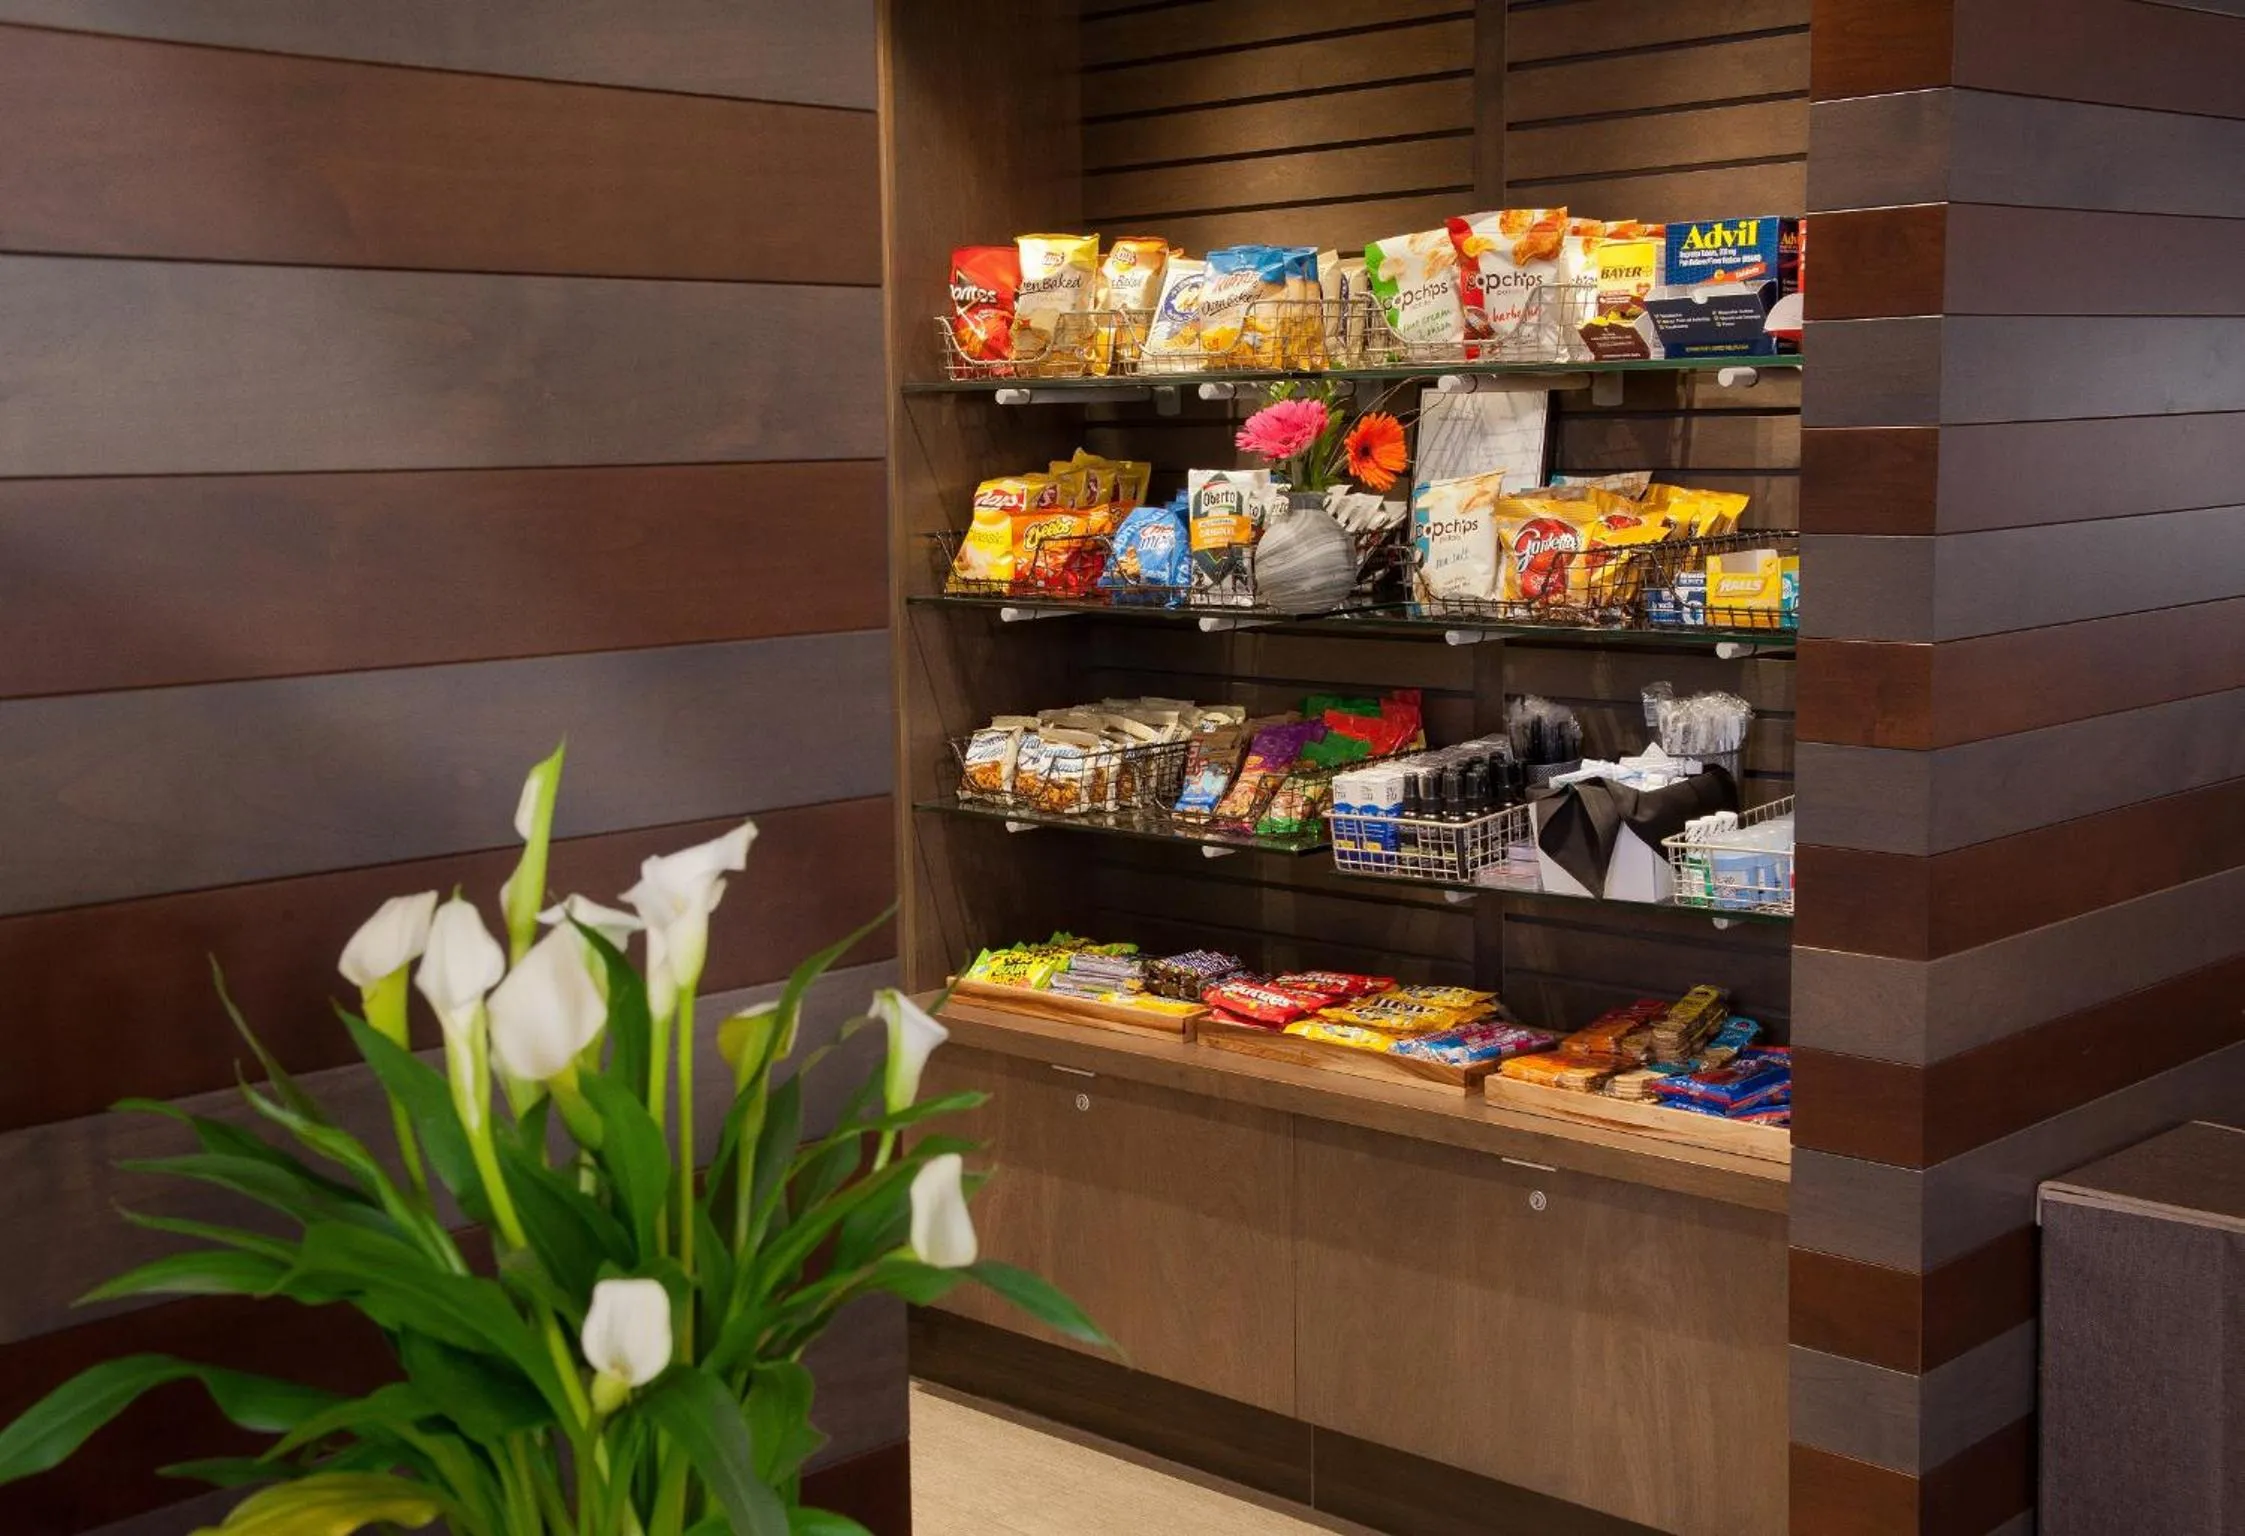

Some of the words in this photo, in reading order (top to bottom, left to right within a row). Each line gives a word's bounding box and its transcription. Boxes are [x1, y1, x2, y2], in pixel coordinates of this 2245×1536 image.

[1681, 220, 1758, 250] Advil
[1043, 273, 1082, 290] Baked
[1466, 272, 1543, 294] popchips
[1601, 266, 1642, 279] BAYER
[1383, 281, 1449, 313] popchips
[1203, 490, 1236, 507] Oberto
[1024, 518, 1073, 550] Cheetos
[1415, 518, 1479, 543] popchips
[1719, 578, 1764, 592] HALLS
